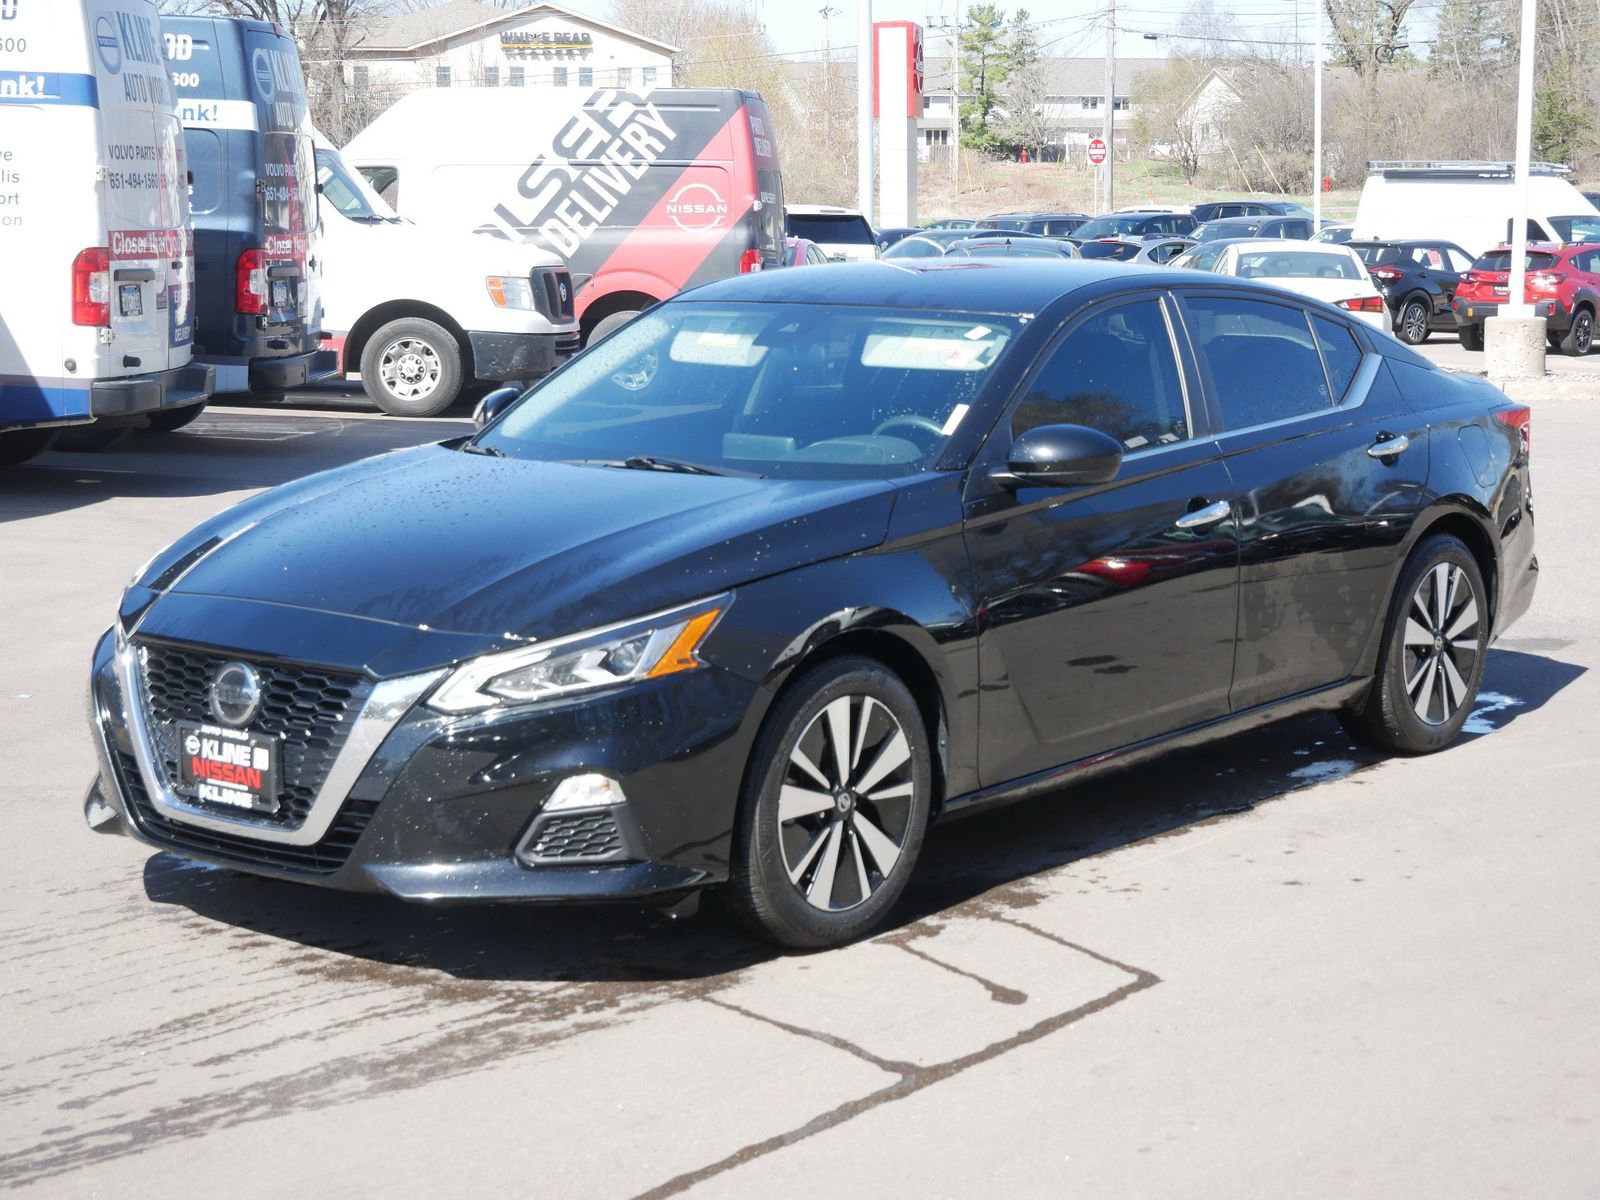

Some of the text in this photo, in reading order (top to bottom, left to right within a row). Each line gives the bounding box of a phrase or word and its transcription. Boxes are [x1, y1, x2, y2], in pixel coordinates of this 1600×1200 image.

[500, 32, 592, 44] WHIE BEAR
[122, 72, 147, 104] AUTO
[108, 144, 135, 161] VOLVO
[135, 145, 156, 161] PARTS
[265, 163, 299, 177] VOLVO PART
[537, 101, 678, 259] DELIVERY
[265, 186, 300, 201] 651-494-15
[666, 204, 728, 215] NISSAN
[112, 231, 148, 256] Closer
[202, 738, 251, 767] KLINE
[191, 756, 262, 791] NISSAN
[199, 783, 253, 809] KLINE
